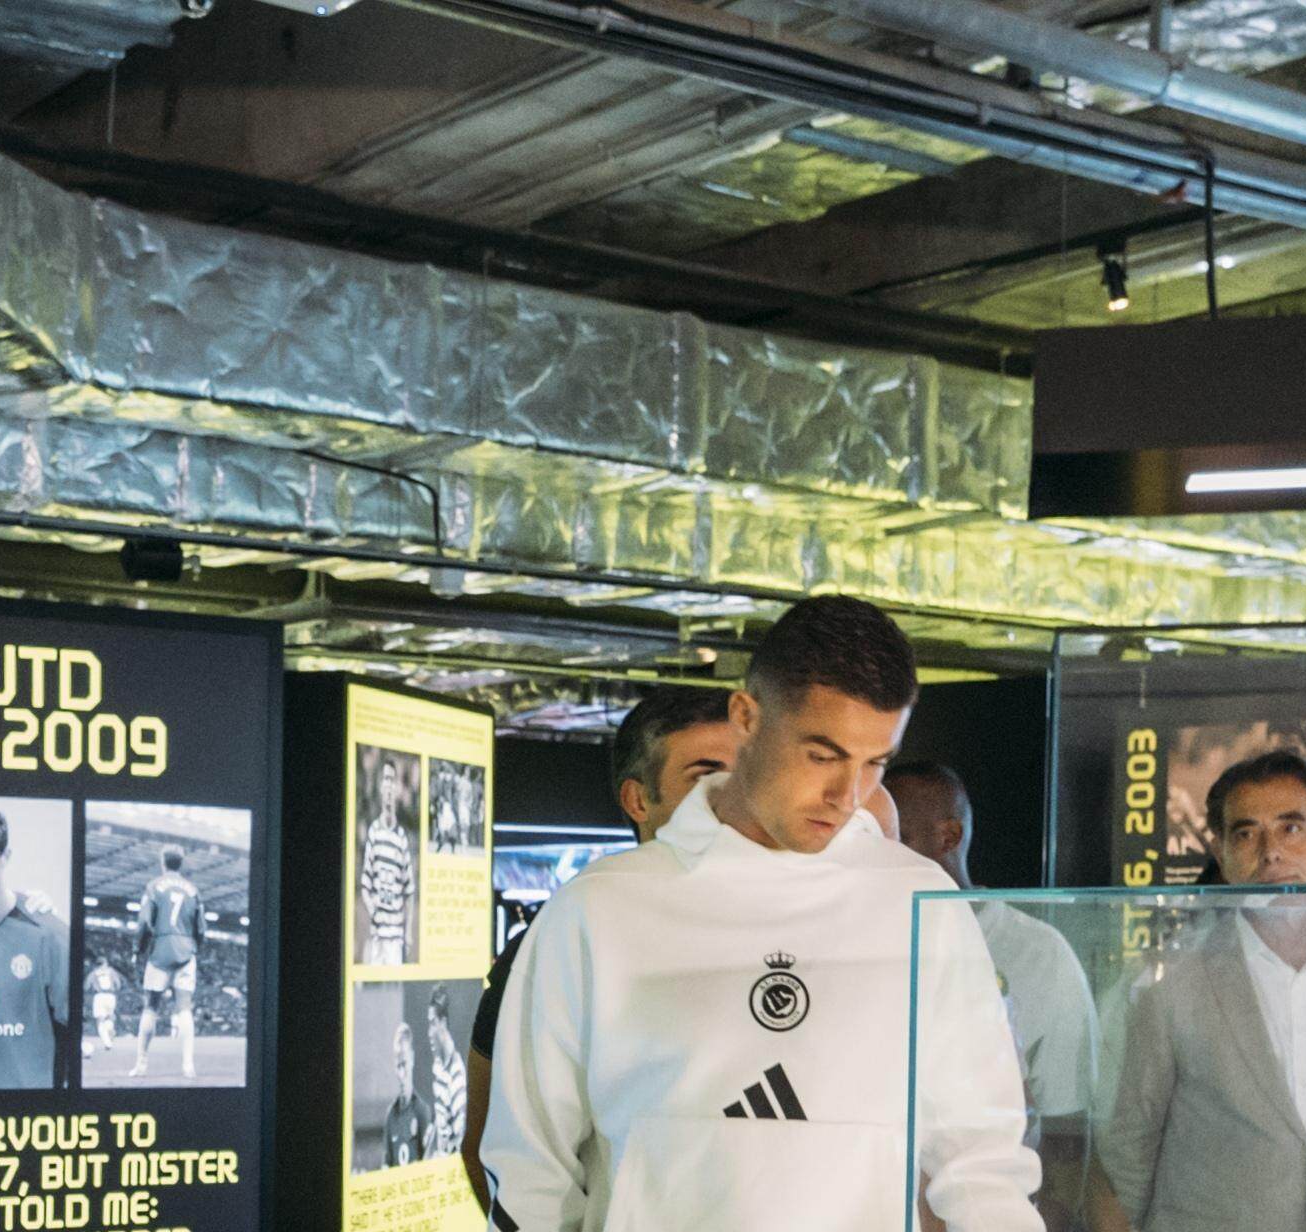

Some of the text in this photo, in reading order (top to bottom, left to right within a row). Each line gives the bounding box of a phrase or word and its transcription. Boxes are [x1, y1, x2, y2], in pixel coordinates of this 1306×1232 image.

[1125, 728, 1157, 834] 2003
[109, 1113, 156, 1149] TO
[40, 1154, 109, 1190] BUT
[121, 1151, 238, 1186] MISTER
[103, 1192, 158, 1226] ME:
